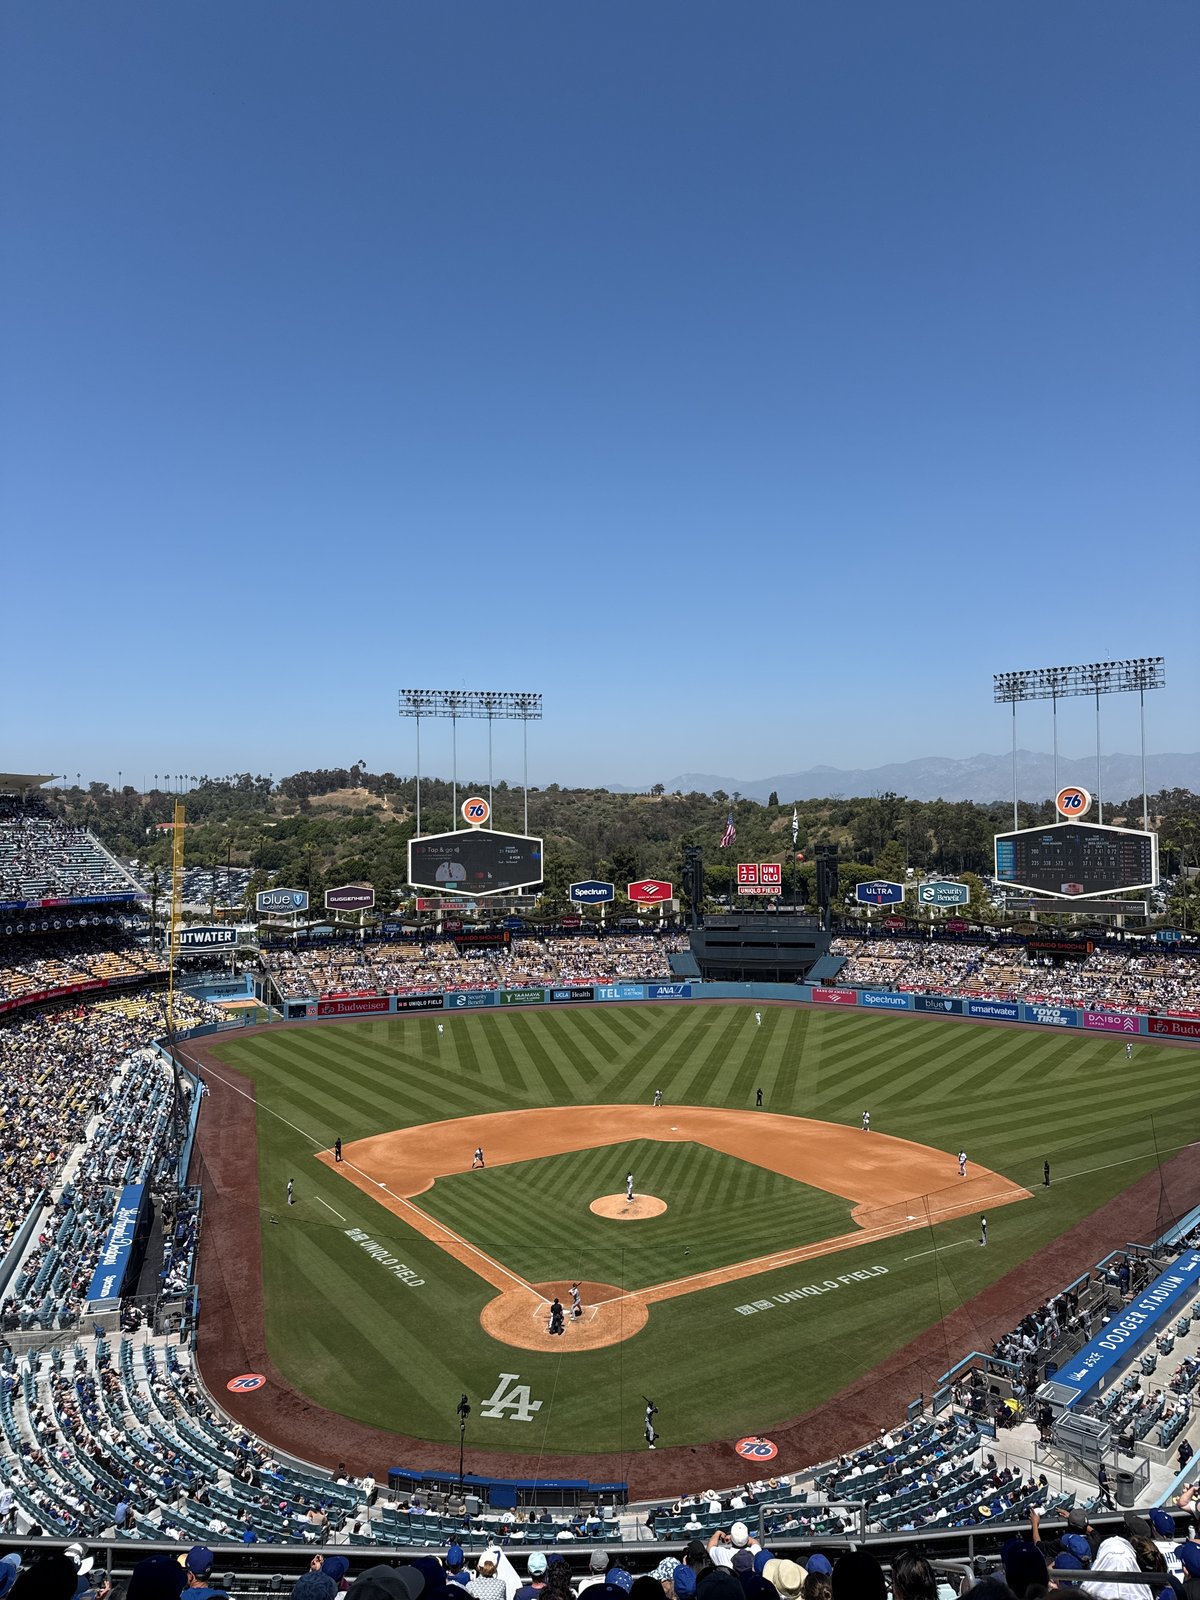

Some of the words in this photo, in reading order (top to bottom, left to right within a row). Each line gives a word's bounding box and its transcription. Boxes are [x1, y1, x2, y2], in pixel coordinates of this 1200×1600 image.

[1063, 795, 1082, 808] 76
[469, 804, 484, 817] 76
[575, 889, 607, 897] Spectrum
[937, 888, 962, 896] Security
[263, 894, 290, 905] blue
[1160, 931, 1178, 939] TEL
[600, 989, 620, 998] TEL
[865, 994, 902, 1006] Spectrum
[926, 1000, 943, 1008] blue
[338, 1001, 386, 1012] Budweiser
[971, 1005, 1017, 1016] smartwater
[1032, 1008, 1061, 1017] TOYO
[1036, 1015, 1067, 1025] TIRES
[1088, 1014, 1121, 1025] DAISO
[360, 1240, 398, 1265] UNIQLO
[388, 1264, 425, 1287] FIELD
[772, 1280, 839, 1304] UNIQLO
[837, 1265, 889, 1284] FIELD
[1098, 1311, 1149, 1350] DODGER
[1139, 1275, 1185, 1311] STADIUM
[230, 1376, 263, 1389] 76
[480, 1373, 543, 1421] LA
[741, 1442, 772, 1457] 76
